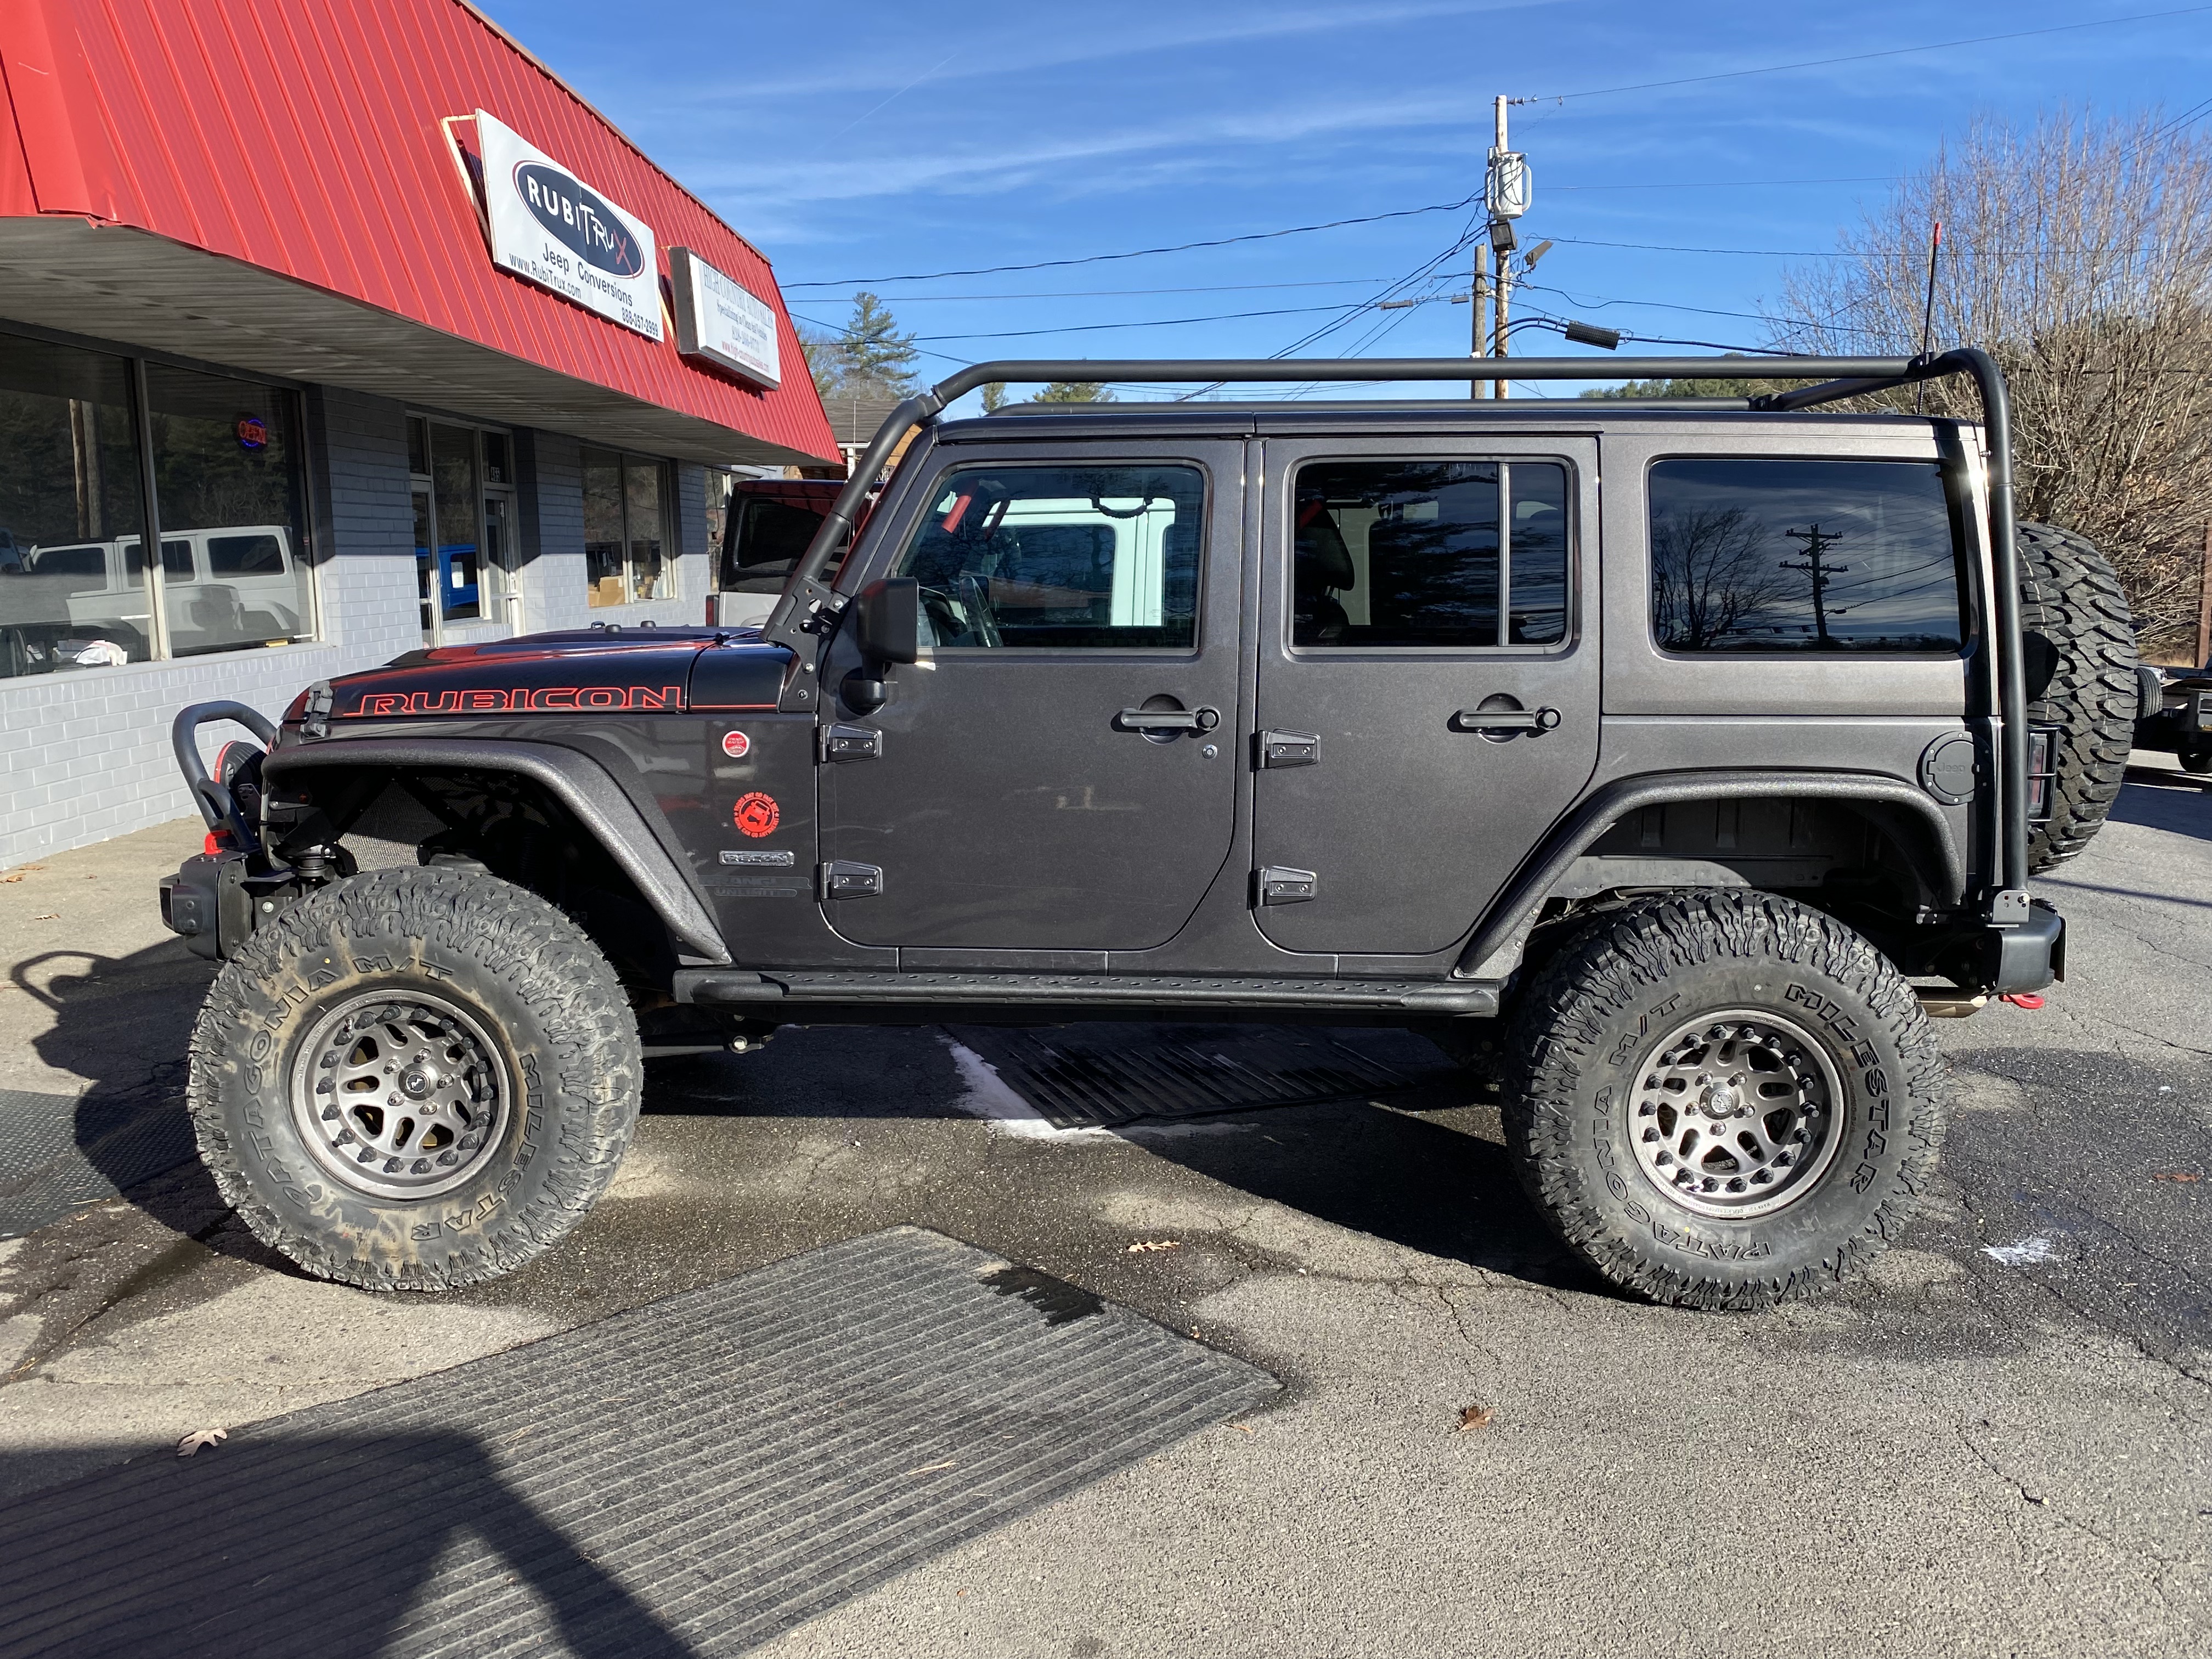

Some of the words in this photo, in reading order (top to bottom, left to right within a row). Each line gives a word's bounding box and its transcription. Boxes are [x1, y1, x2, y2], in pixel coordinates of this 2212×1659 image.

[509, 253, 581, 299] www.RubiTrux.com
[543, 243, 569, 273] Jeep
[578, 261, 632, 307] Conversions
[703, 264, 720, 295] HIGH
[720, 276, 746, 312] COUNTRY
[622, 308, 658, 337] 888-357-2999
[239, 421, 267, 444] OPEN
[361, 686, 681, 714] RUBICON
[1936, 763, 1966, 775] Jeep
[724, 854, 788, 862] RECON
[1609, 991, 1683, 1066] M/T
[242, 969, 340, 1209] PATAGONIA
[352, 955, 455, 981] M/T
[1785, 983, 1889, 1195] MILESTAR
[410, 1052, 544, 1242] MILESTAR
[1593, 1084, 1771, 1261] PATAGONIA
